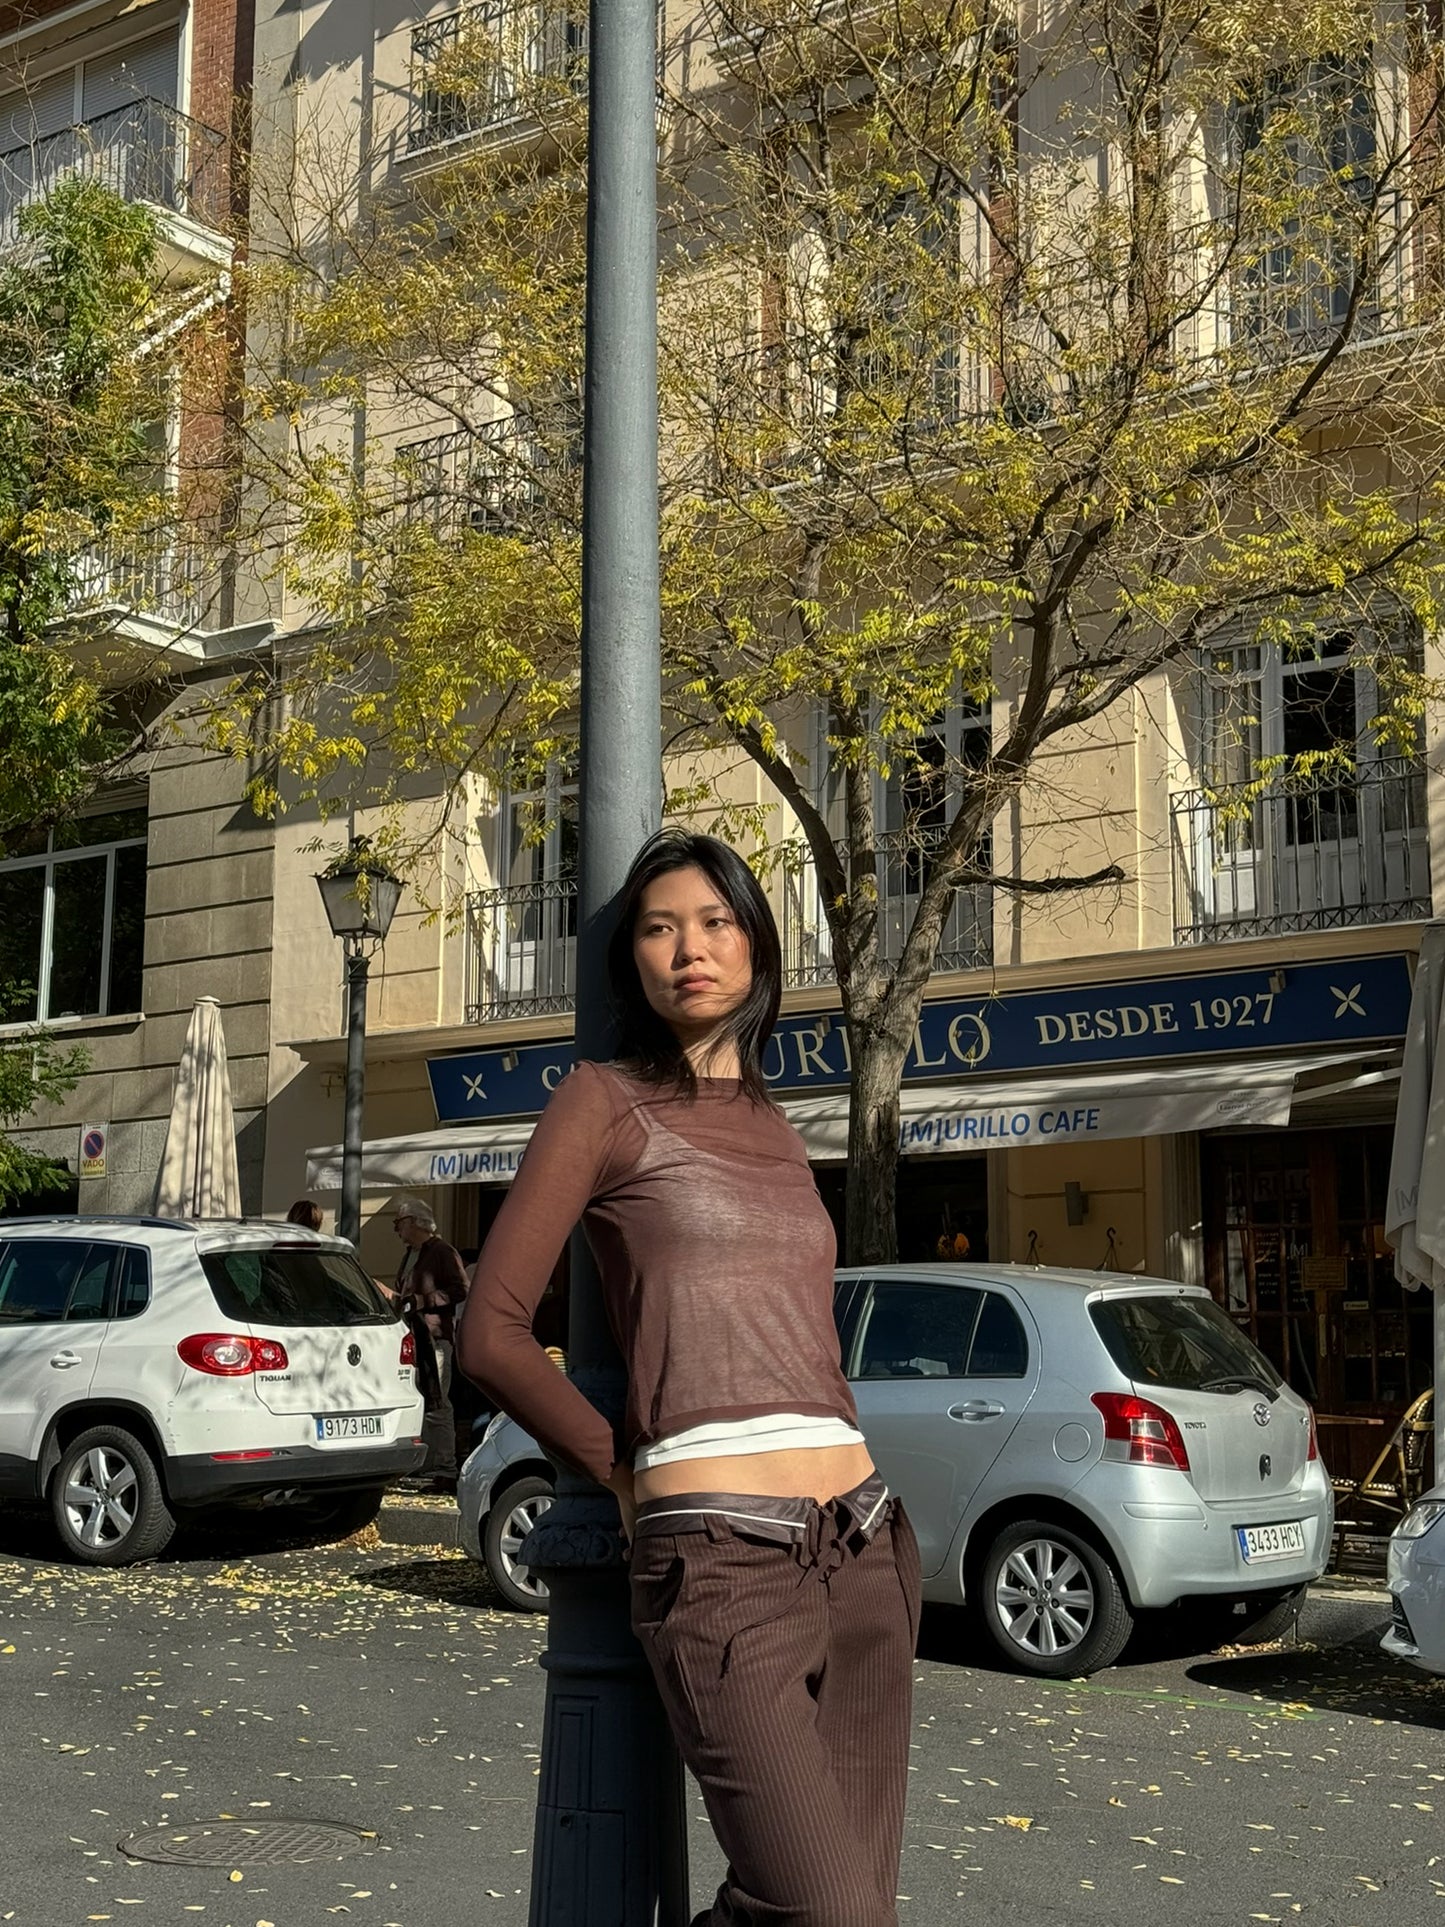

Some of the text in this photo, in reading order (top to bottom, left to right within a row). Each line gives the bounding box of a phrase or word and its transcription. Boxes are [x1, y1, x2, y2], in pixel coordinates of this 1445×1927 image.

[1034, 1003, 1179, 1045] DESDE
[1190, 993, 1274, 1030] 1927
[900, 1108, 1101, 1148] [M]URILLO CAFE
[82, 1158, 104, 1168] VADO
[260, 1374, 292, 1382] TIGUAN
[325, 1418, 358, 1437] 9173
[1248, 1525, 1301, 1553] 3433 HCY
